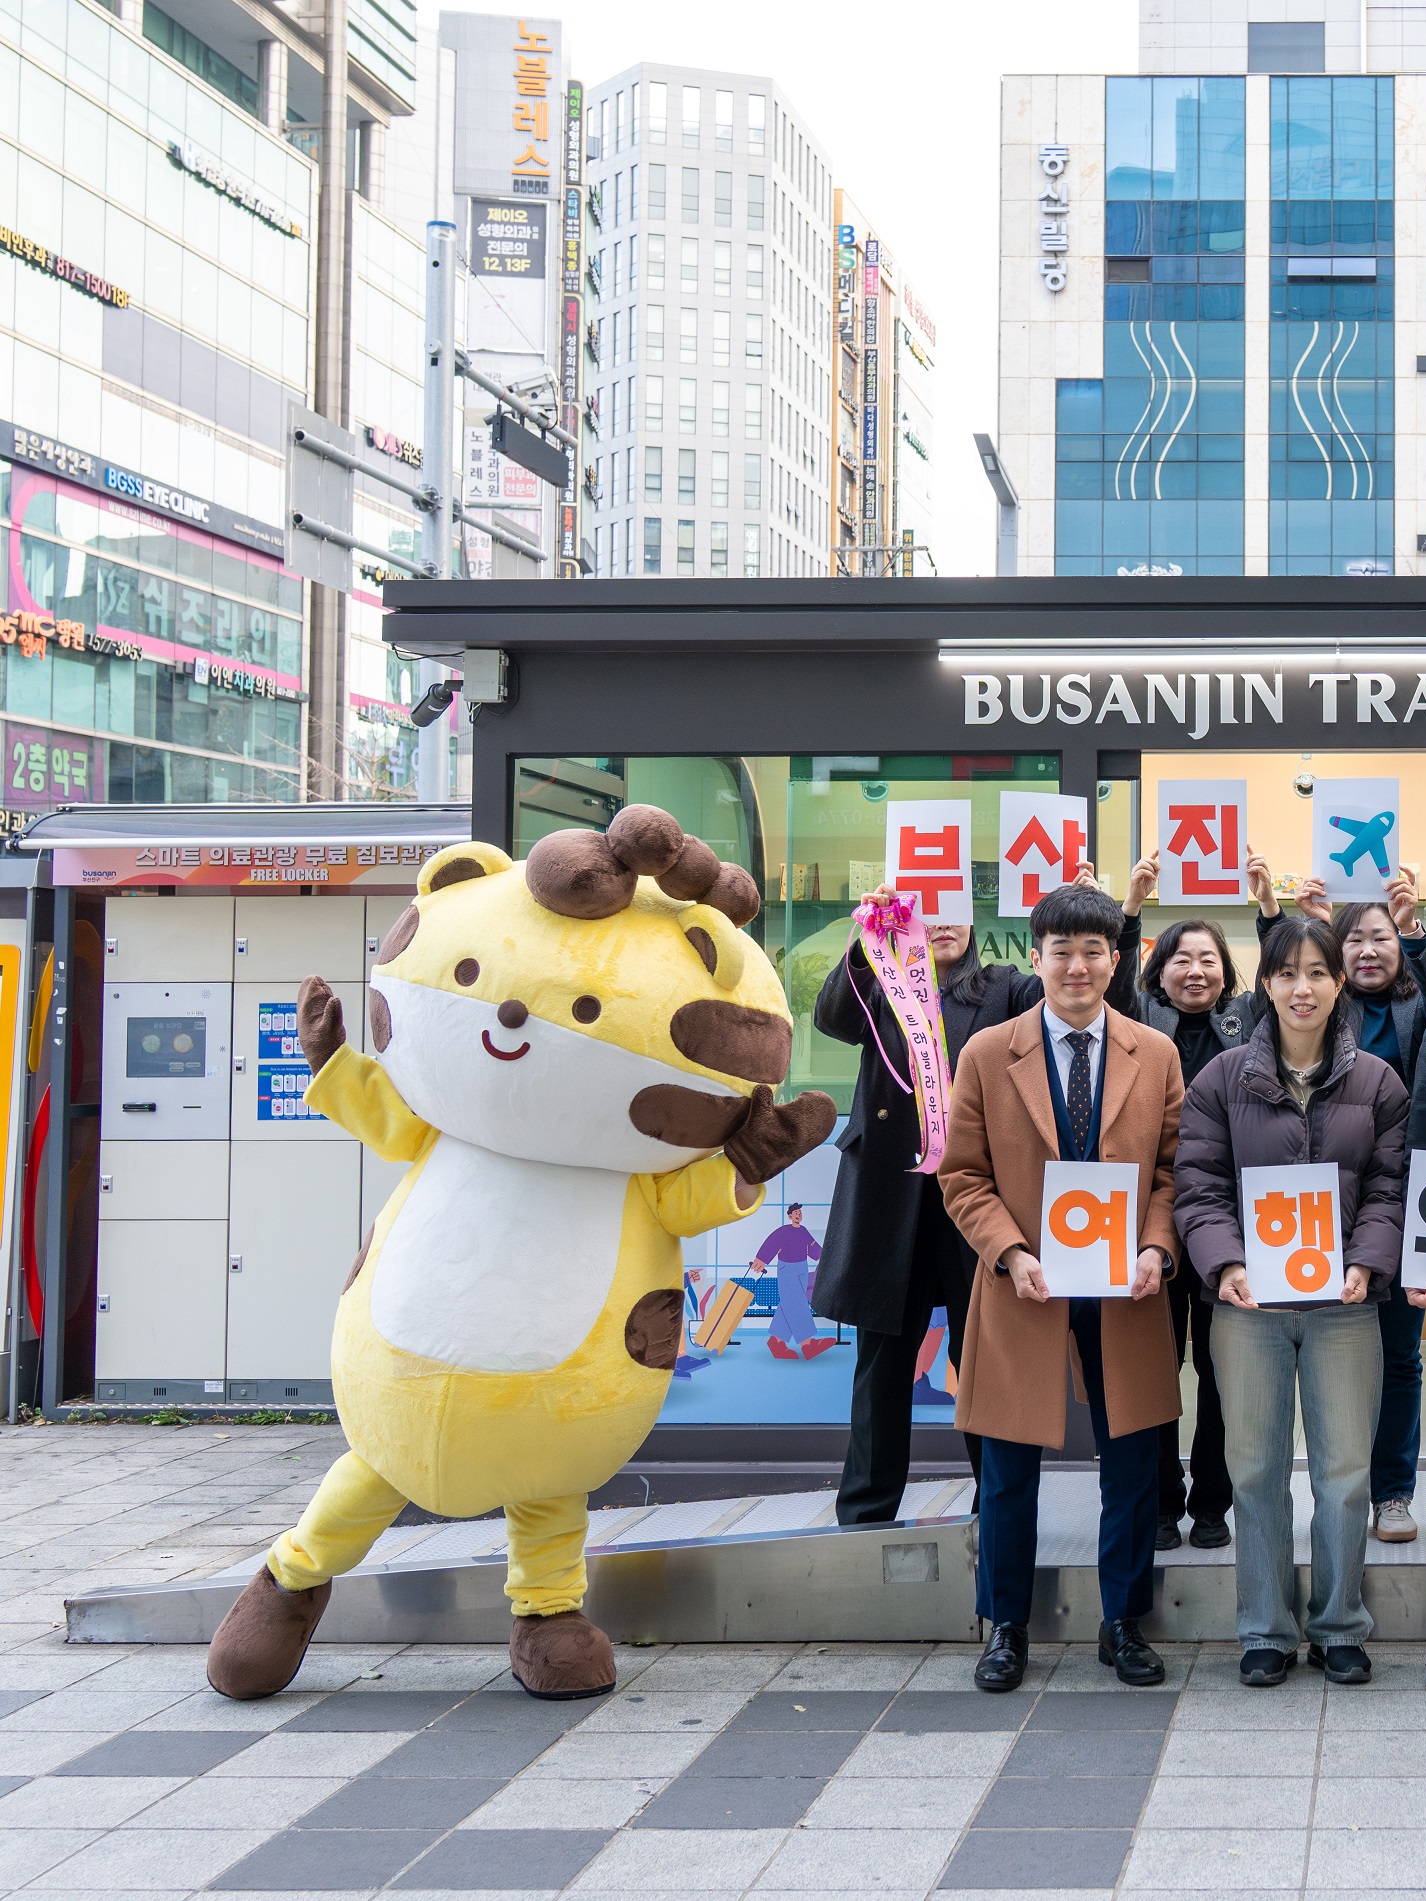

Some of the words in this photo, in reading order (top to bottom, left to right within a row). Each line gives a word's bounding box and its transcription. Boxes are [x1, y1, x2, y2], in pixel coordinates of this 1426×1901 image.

[511, 19, 552, 177] 노블레스
[568, 88, 581, 118] 제이오
[476, 223, 532, 241] 성형외과
[486, 207, 529, 224] 제이오
[1038, 143, 1069, 293] 동신빌딩
[486, 241, 528, 257] 전문의
[504, 257, 532, 273] 13F
[56, 255, 112, 301] 817-1500
[470, 430, 484, 498] 노블레스
[106, 467, 143, 498] BGSS
[143, 480, 170, 510] EYE
[143, 578, 270, 664] 쉬즈라인
[87, 632, 144, 662] 1577-3653
[210, 662, 277, 699] 이엔치과의원
[961, 672, 1287, 741] BUSANJIN
[82, 868, 117, 880] busanjin
[136, 847, 202, 868] 스마트
[209, 846, 297, 867] 의료관광
[305, 845, 348, 866] 무료
[250, 867, 280, 882] FREE
[281, 867, 330, 882] LOCKER
[895, 825, 963, 915] 부
[1005, 816, 1087, 907] 산
[1167, 805, 1239, 895] 진
[910, 968, 929, 1004] 멋진
[872, 948, 907, 1000] 부산진
[906, 1014, 941, 1135] 트래블라운지
[1049, 1190, 1128, 1286] 여
[1254, 1191, 1335, 1293] 행
